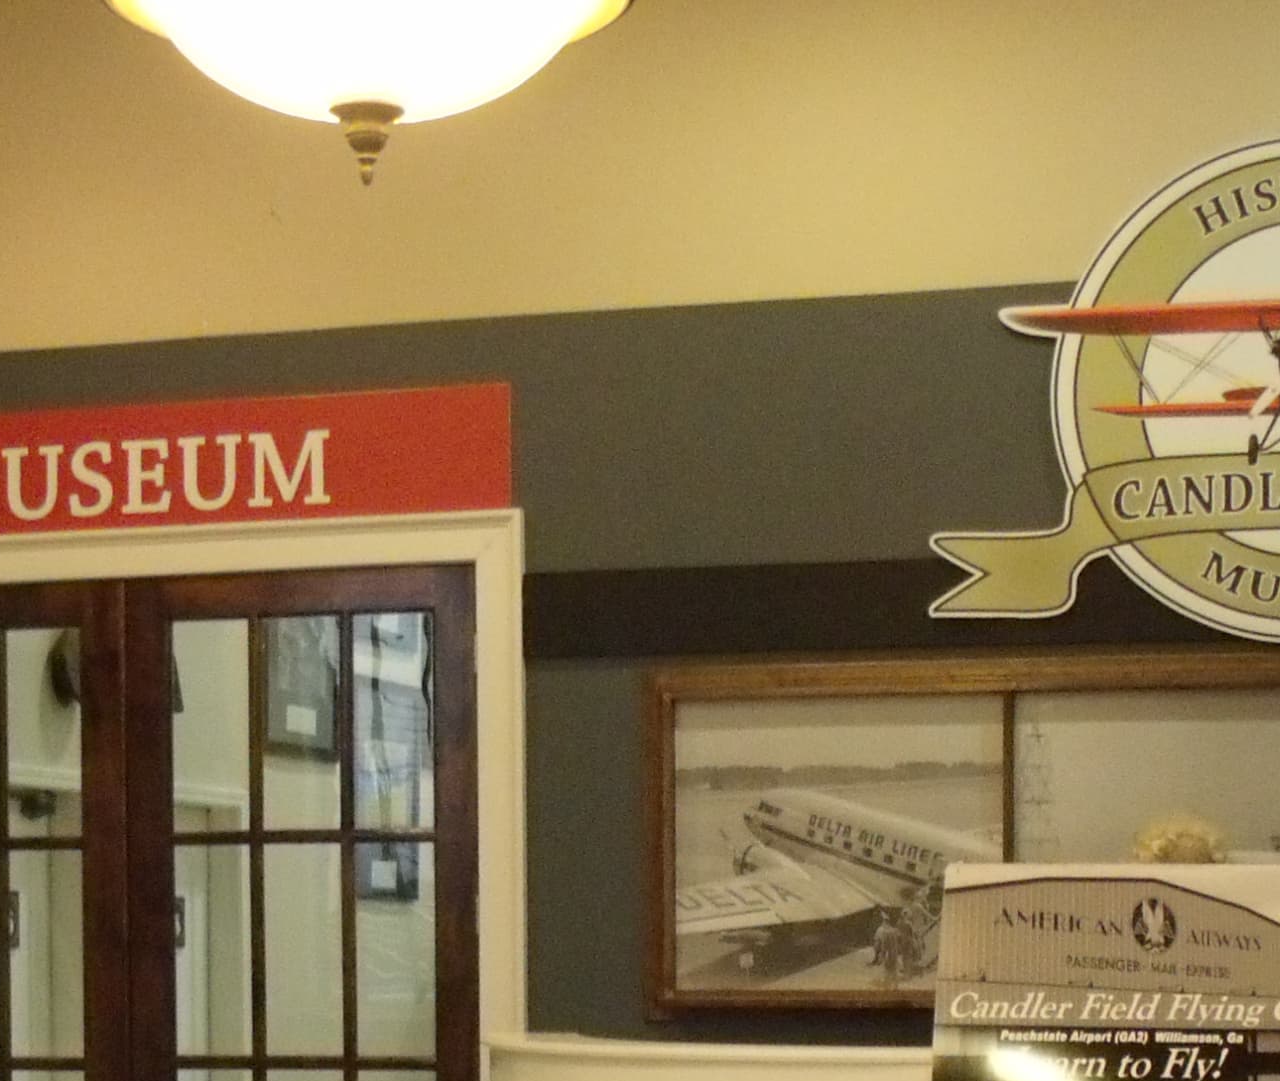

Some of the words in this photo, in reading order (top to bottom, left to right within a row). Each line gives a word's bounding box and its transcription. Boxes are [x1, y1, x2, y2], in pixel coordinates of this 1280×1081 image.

[808, 814, 852, 838] DELTA
[858, 829, 885, 848] AIR
[994, 907, 1123, 938] AMERICAN
[1185, 929, 1262, 952] AIRWAYS
[1066, 956, 1141, 974] PASSENGER
[1149, 961, 1178, 977] MAIL
[949, 991, 1073, 1022] Candler
[1078, 991, 1160, 1023] Field
[1165, 993, 1265, 1028] Flying
[1000, 1030, 1068, 1043] Peachstate
[1069, 1030, 1113, 1045] Airport
[1154, 1031, 1224, 1045] Williamson,
[1226, 1032, 1245, 1044] Ga
[1117, 1054, 1153, 1080] to
